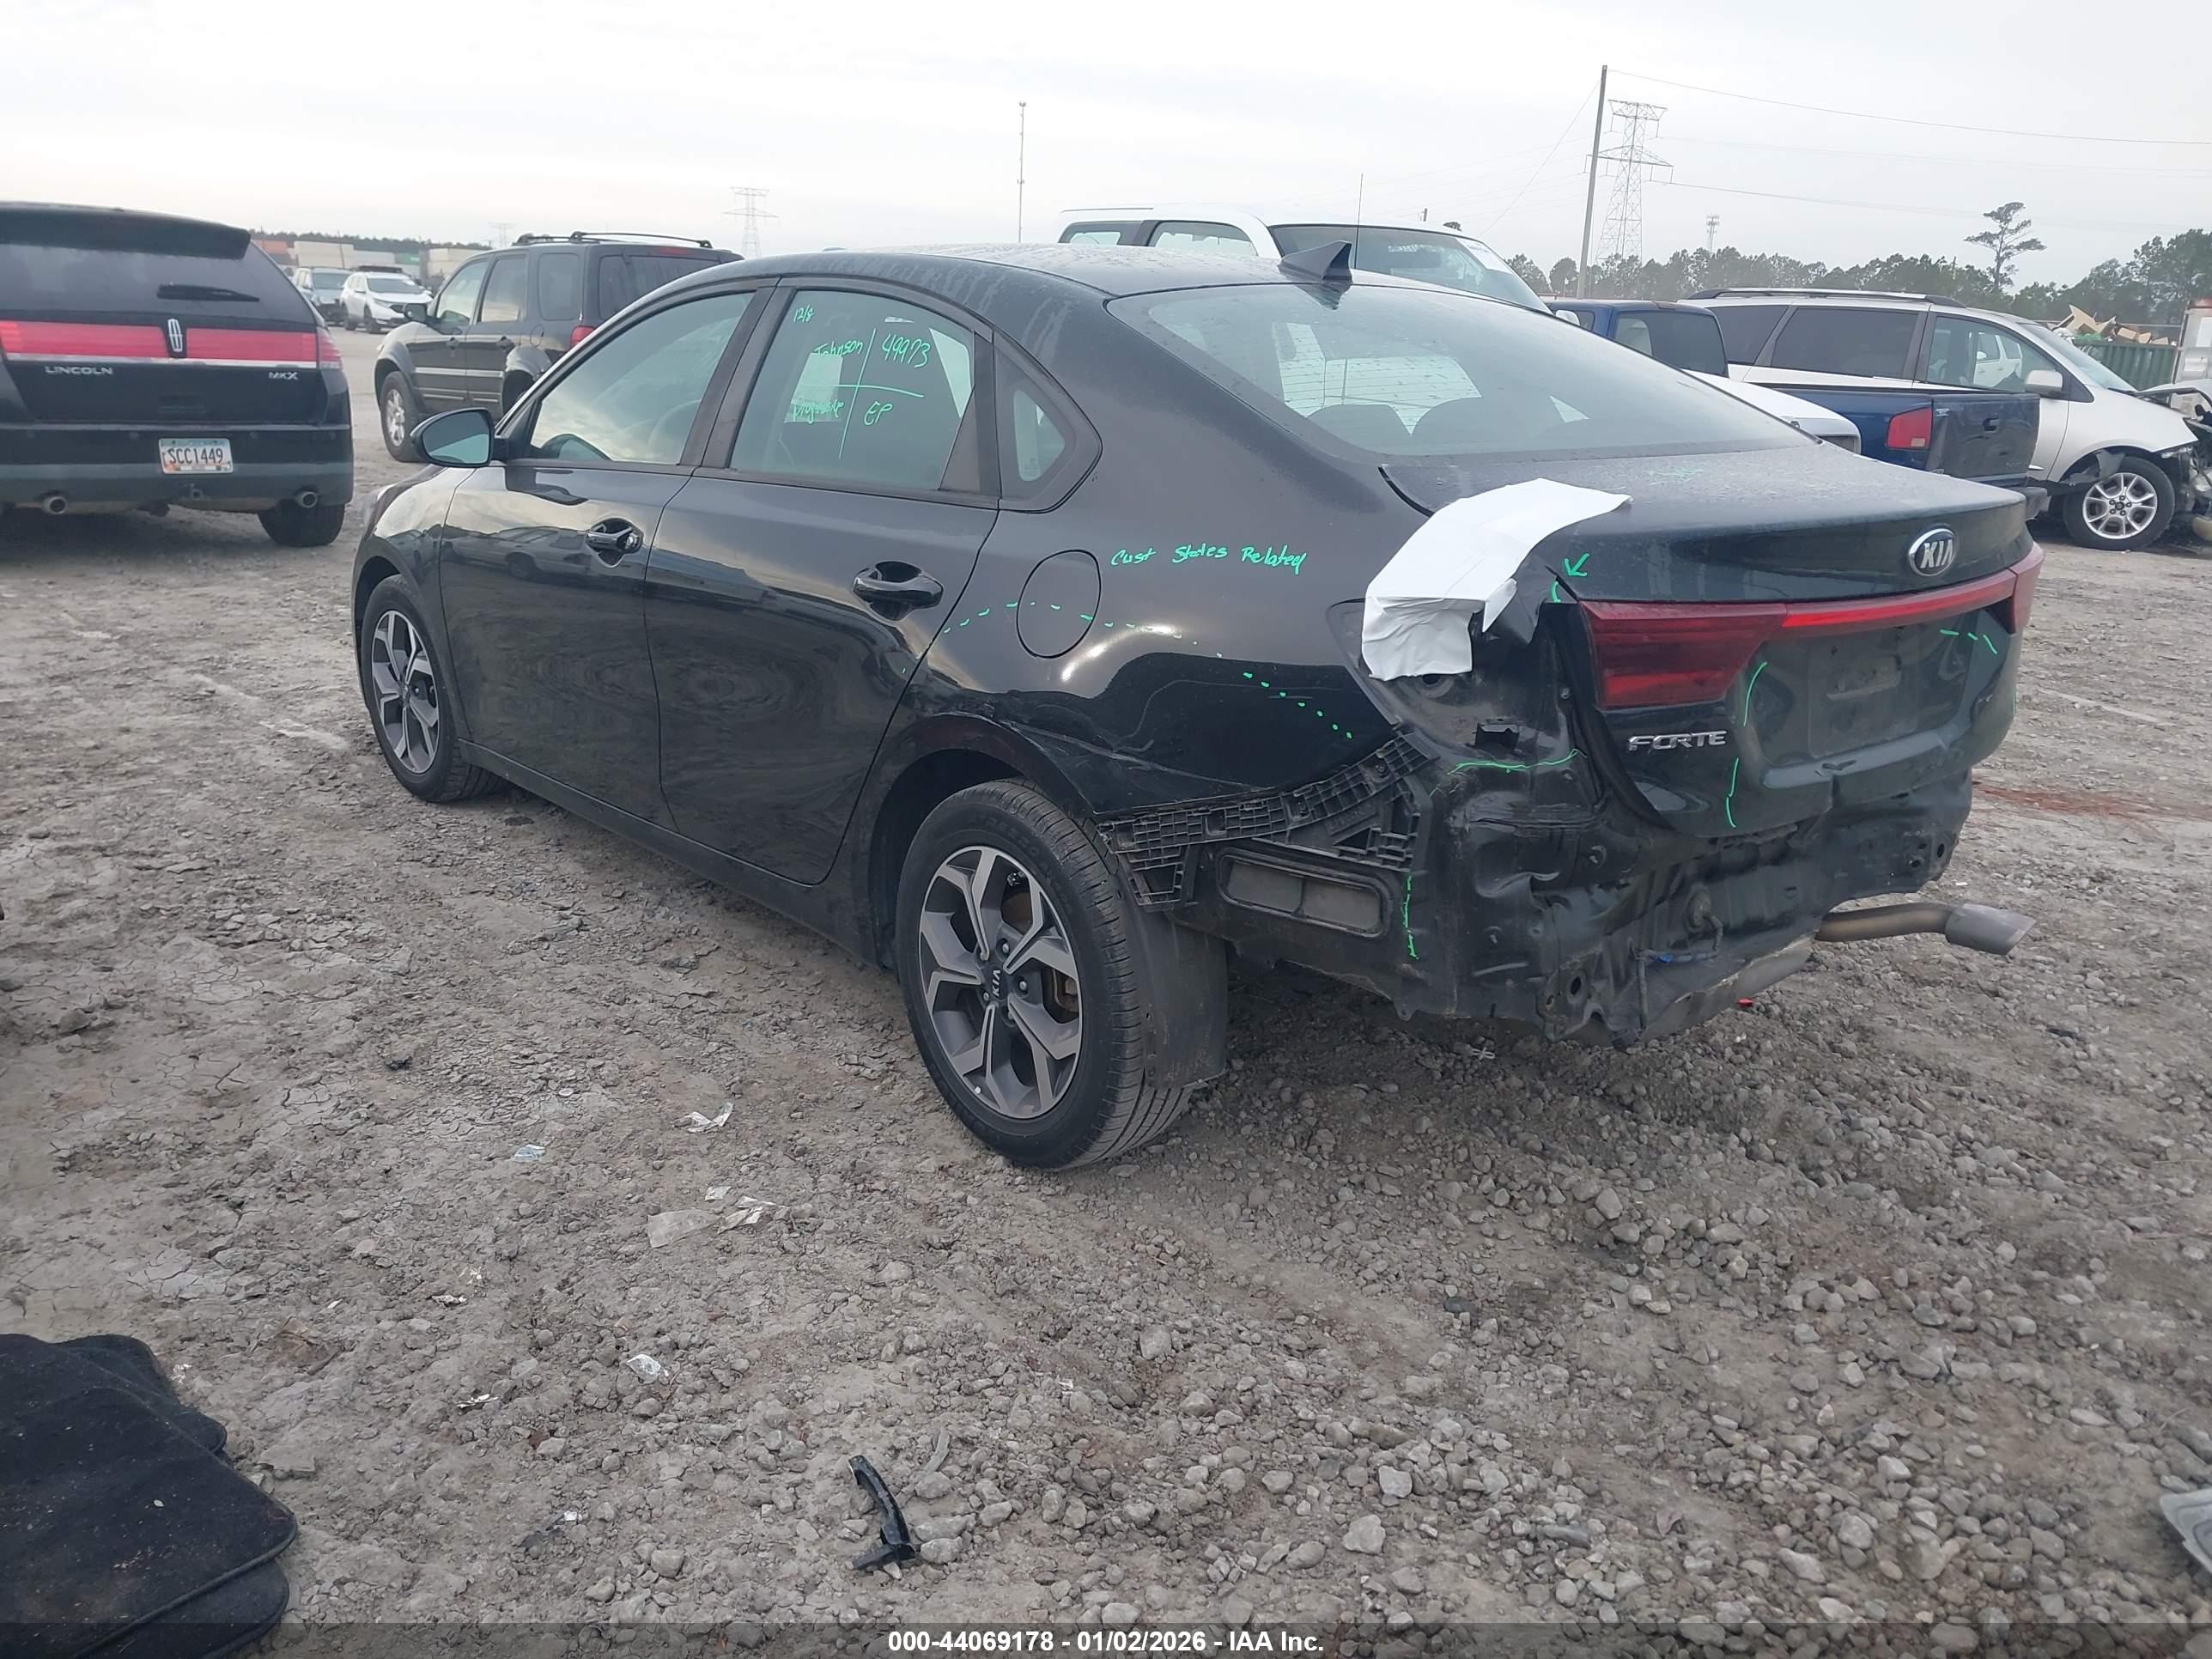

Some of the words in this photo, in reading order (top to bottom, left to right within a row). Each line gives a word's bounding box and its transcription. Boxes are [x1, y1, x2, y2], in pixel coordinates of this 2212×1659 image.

[44, 365, 113, 375] LINCOLN
[268, 371, 299, 380] MKX
[167, 447, 224, 465] SCC1449
[1628, 730, 1728, 751] FORTE
[992, 969, 1001, 997] KIA
